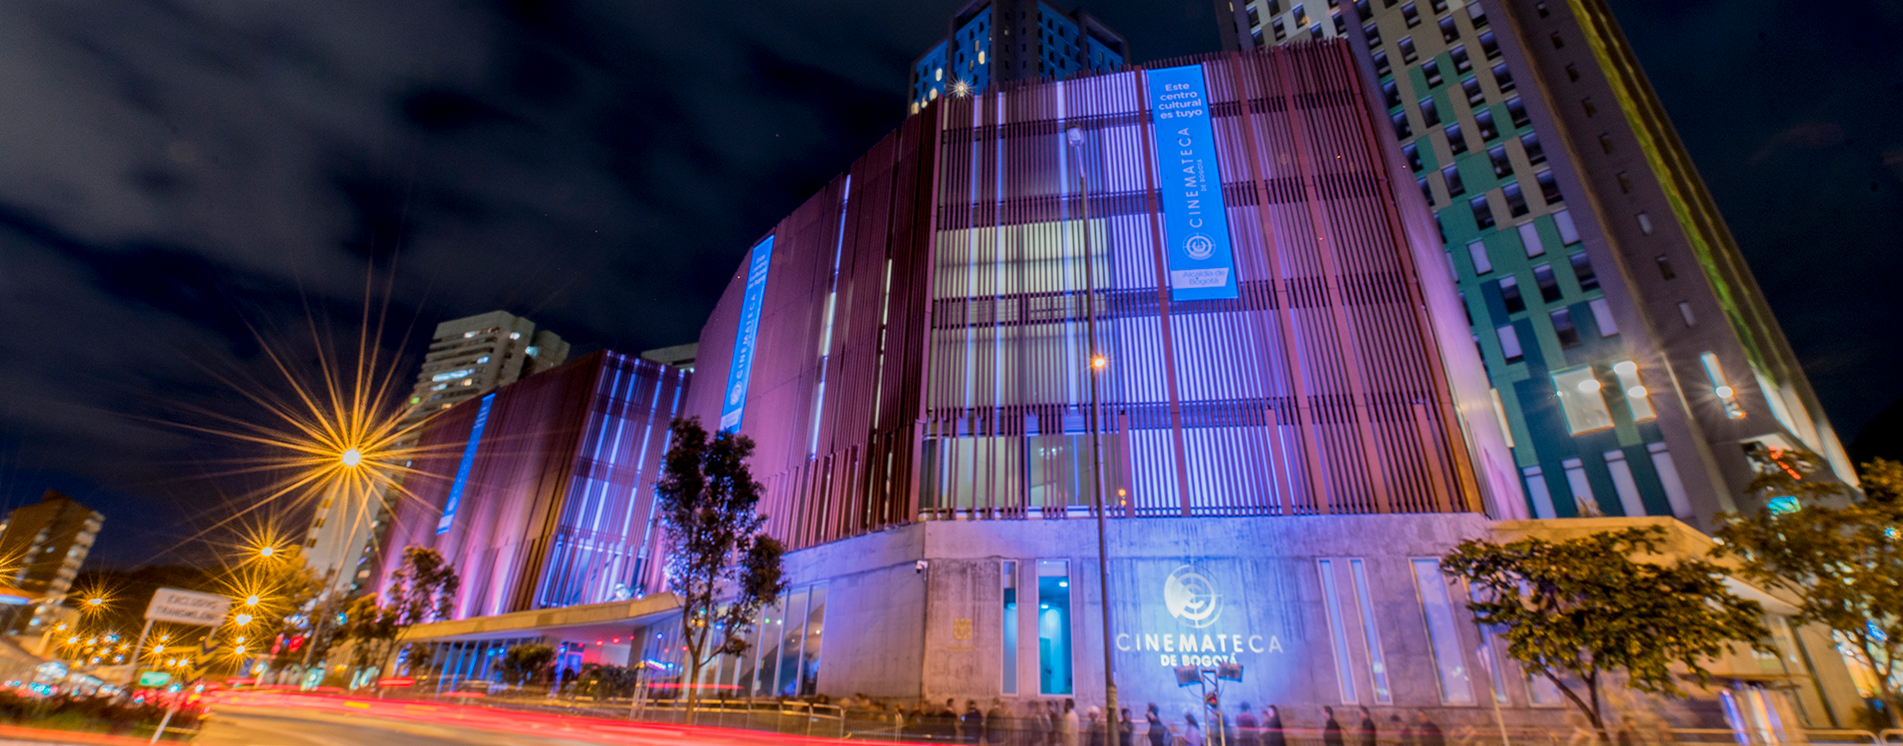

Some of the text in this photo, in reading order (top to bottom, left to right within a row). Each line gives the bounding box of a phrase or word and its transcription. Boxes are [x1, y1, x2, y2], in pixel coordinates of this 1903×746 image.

[1165, 83, 1190, 91] Este
[1160, 91, 1198, 101] centro
[1158, 98, 1202, 110] cultural
[1175, 109, 1203, 118] tuyo
[1178, 127, 1203, 228] CINEMATECA
[1115, 633, 1284, 653] CINEMATECA
[1160, 652, 1238, 667] DE BOGOTÁ
